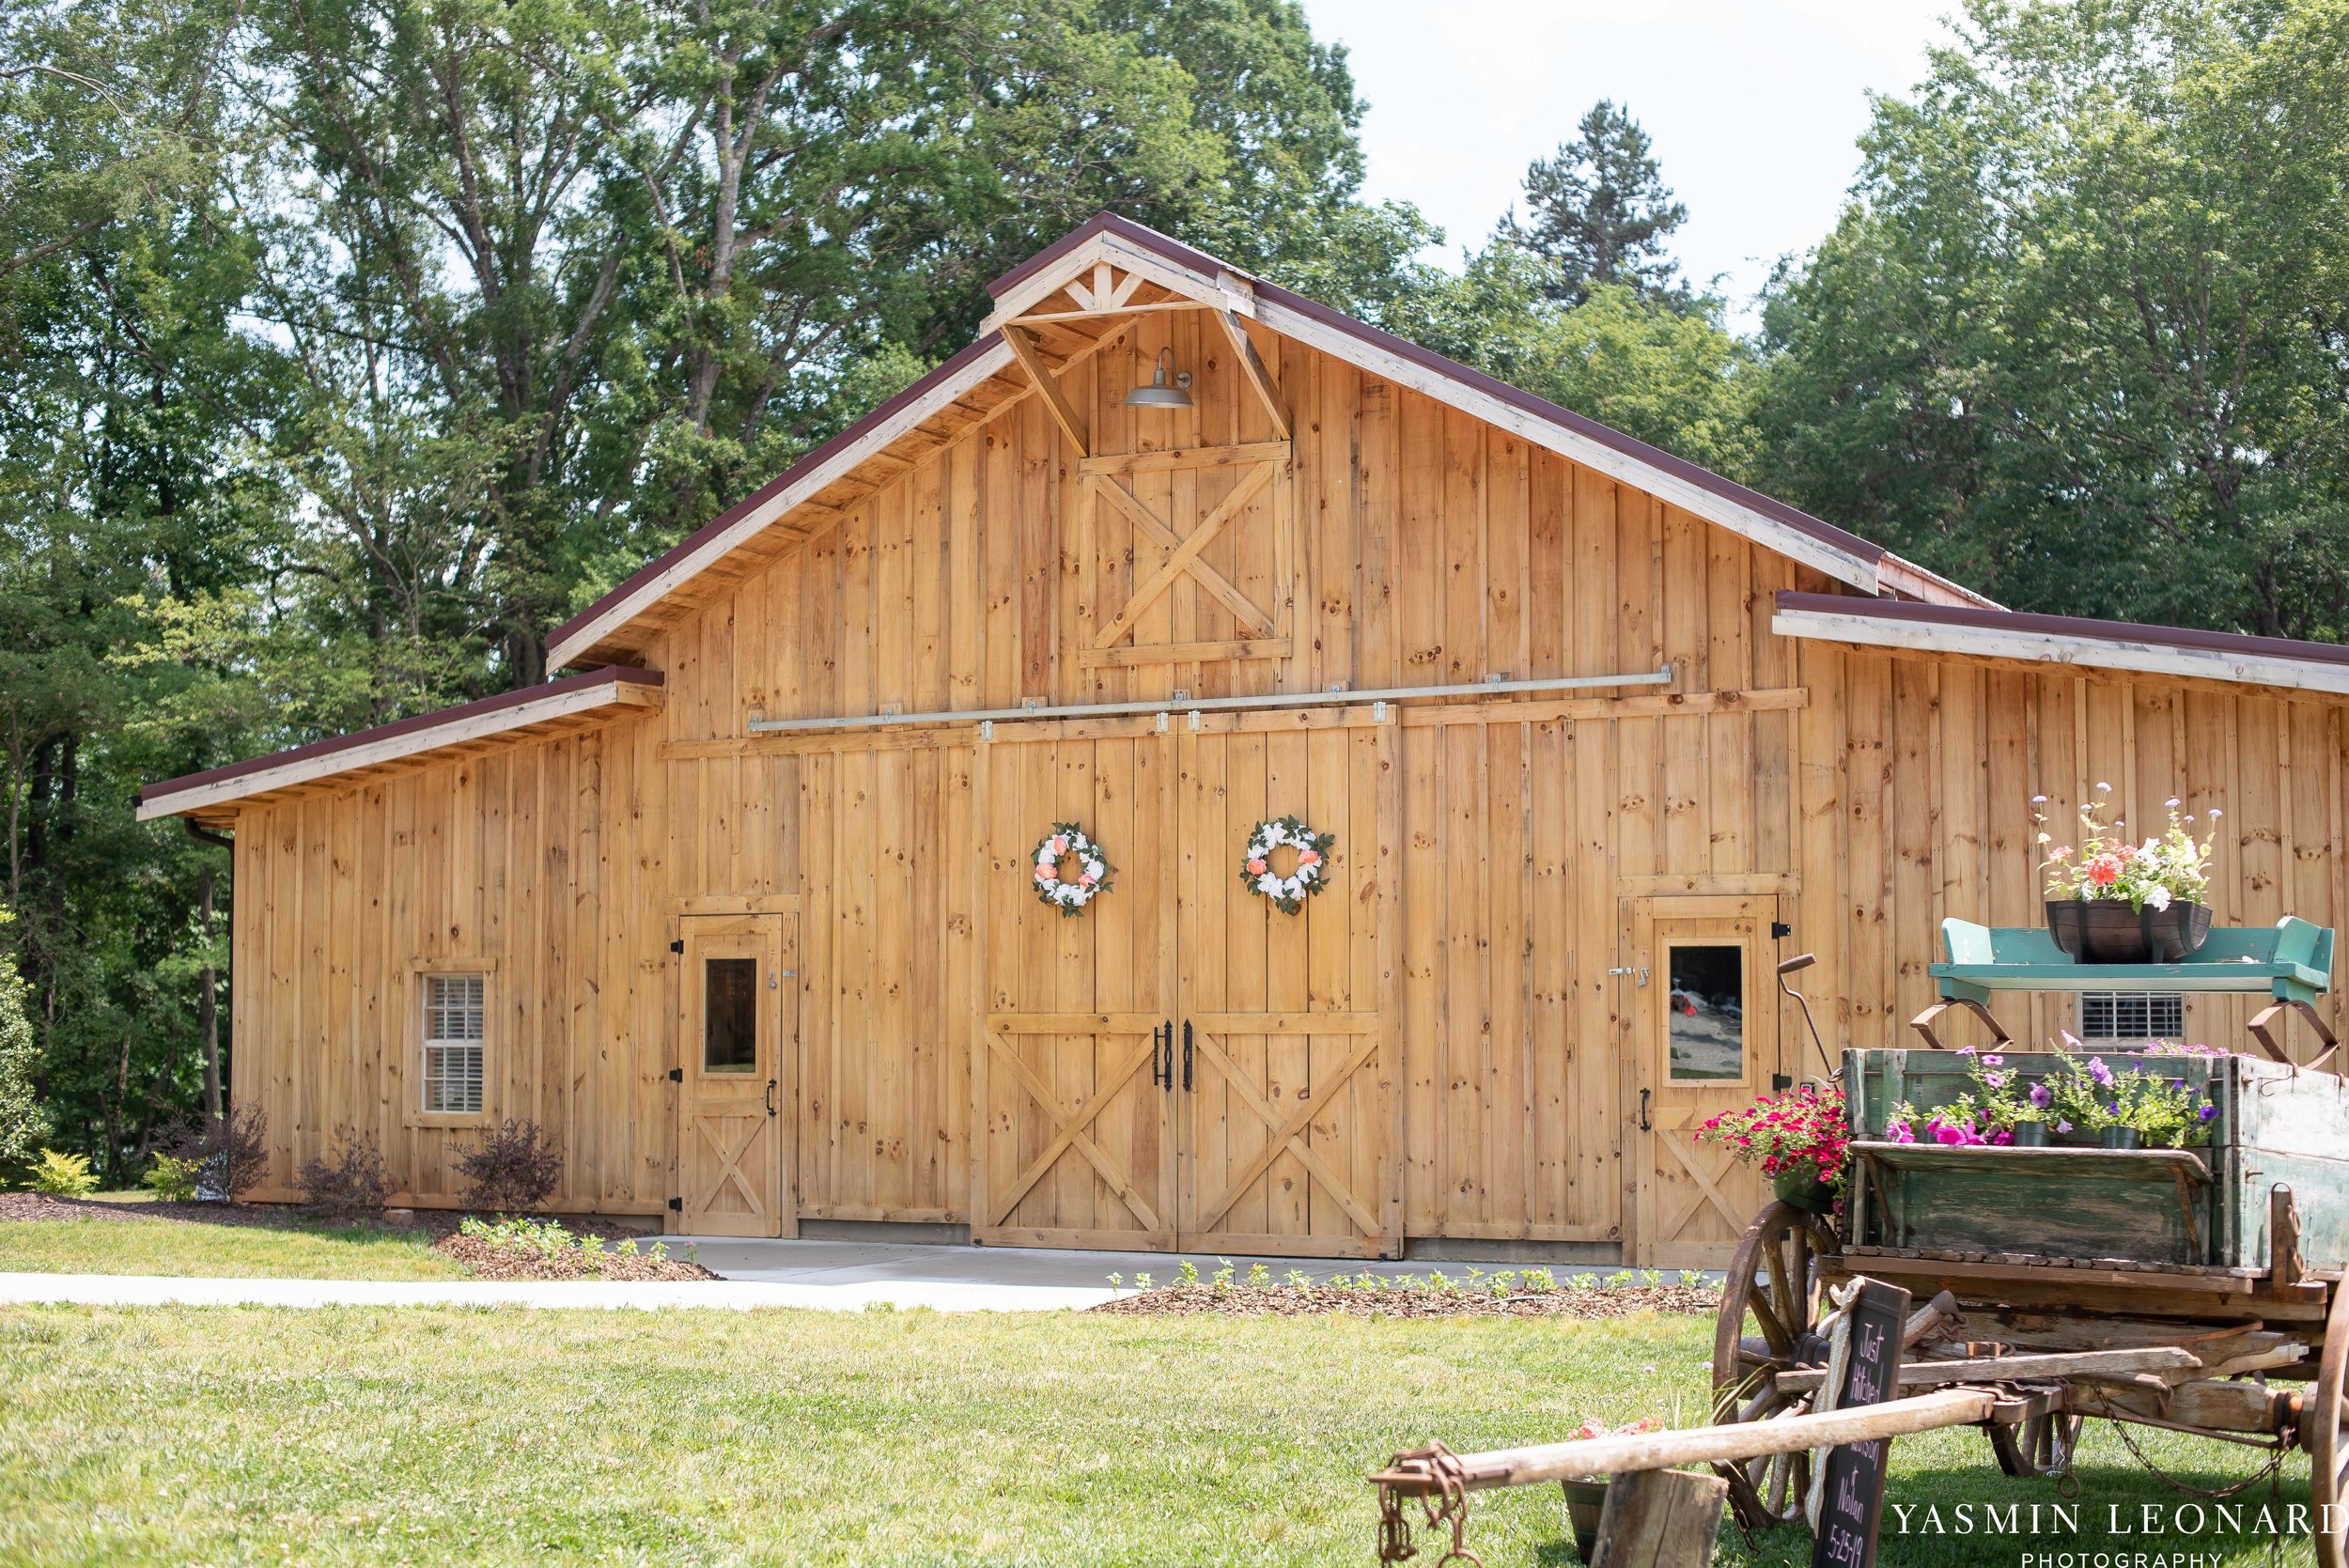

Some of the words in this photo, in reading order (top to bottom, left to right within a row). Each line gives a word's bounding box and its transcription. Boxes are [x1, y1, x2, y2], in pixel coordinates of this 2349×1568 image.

[1859, 1323, 1885, 1364] Just
[1850, 1360, 1885, 1405] Hitched
[1838, 1476, 1865, 1525] Nolan
[1828, 1523, 1864, 1568] 5-25-19
